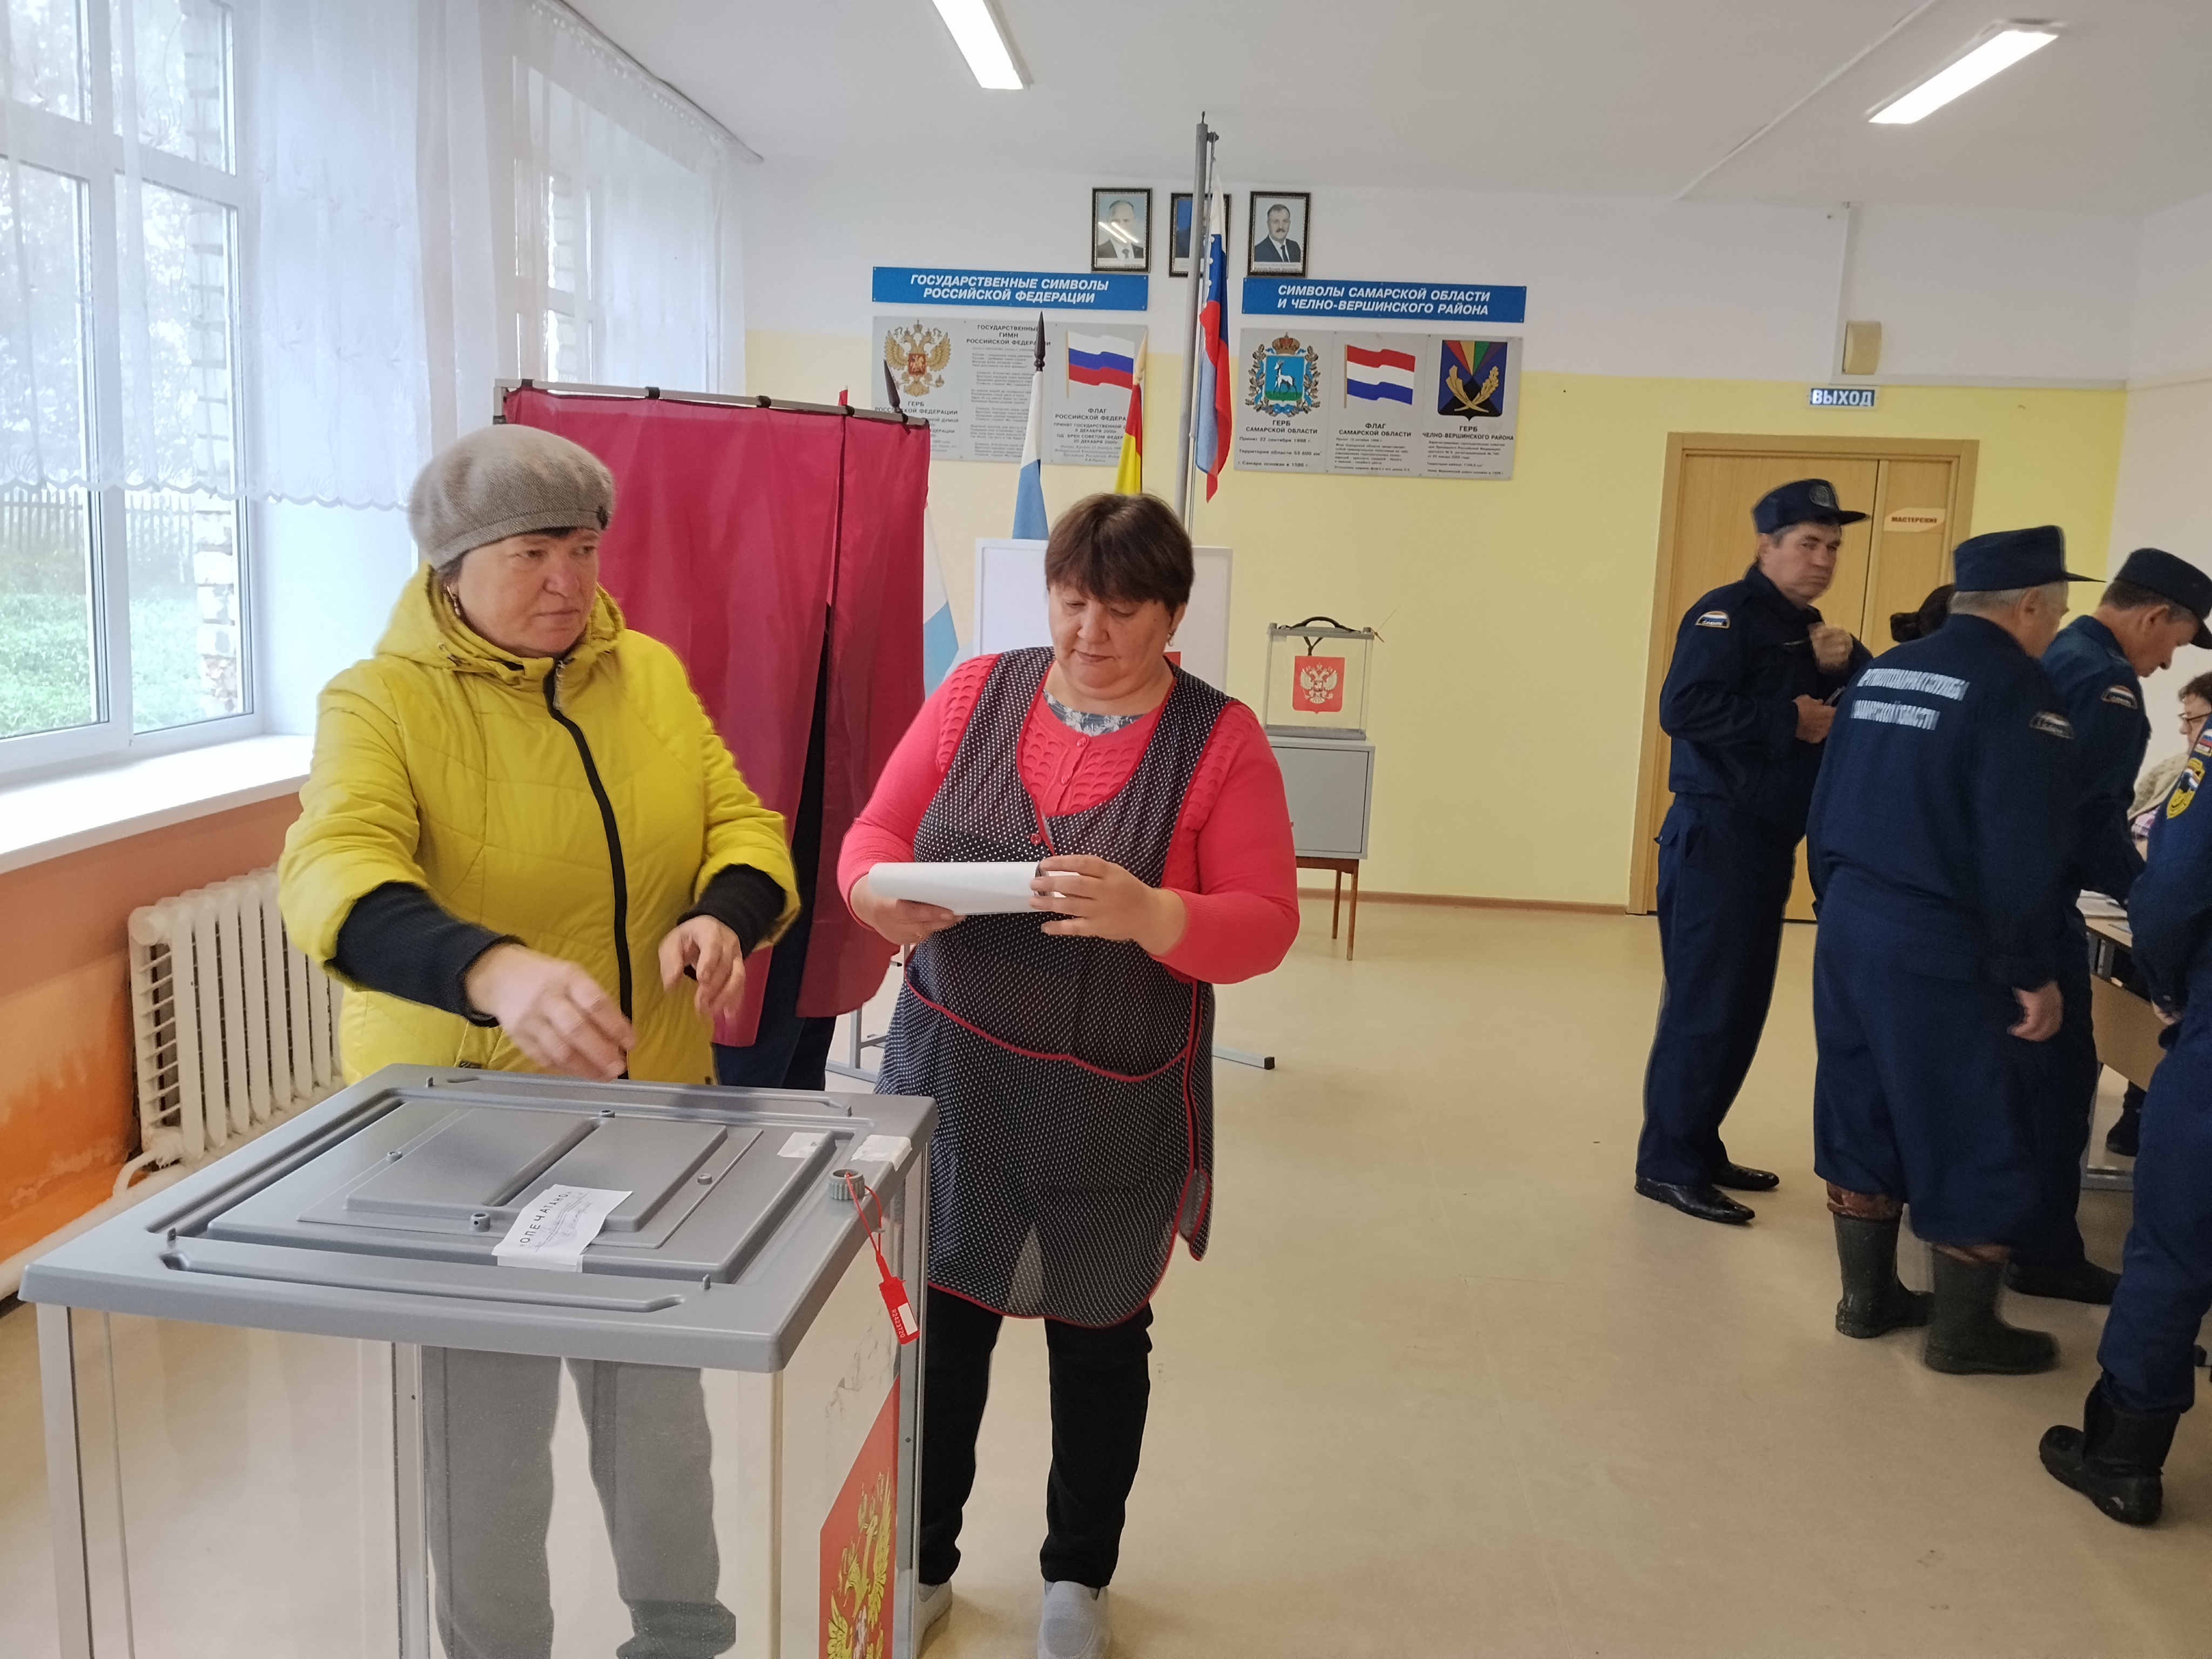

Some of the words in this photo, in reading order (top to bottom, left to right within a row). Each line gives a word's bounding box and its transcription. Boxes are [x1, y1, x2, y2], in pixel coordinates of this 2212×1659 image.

[910, 274, 1038, 289] ГОСУДАРСТВЕННЫЕ
[1041, 278, 1109, 291] СИМВОЛЫ
[923, 287, 1011, 301] РОССИЙСКОЙ
[1015, 290, 1095, 305] ФЕДЕРАЦИИ
[1278, 285, 1345, 297] СИМВОЛЫ
[1348, 287, 1427, 300] САМАРСКОЙ
[1430, 289, 1491, 302] ОБЛАСТИ
[1277, 298, 1287, 309] И
[1291, 298, 1434, 314] ЧЕЛНО-ВЕРШИНСКОГО
[1437, 302, 1489, 315] РАЙОНА
[1812, 389, 1872, 407] ВЫХОД
